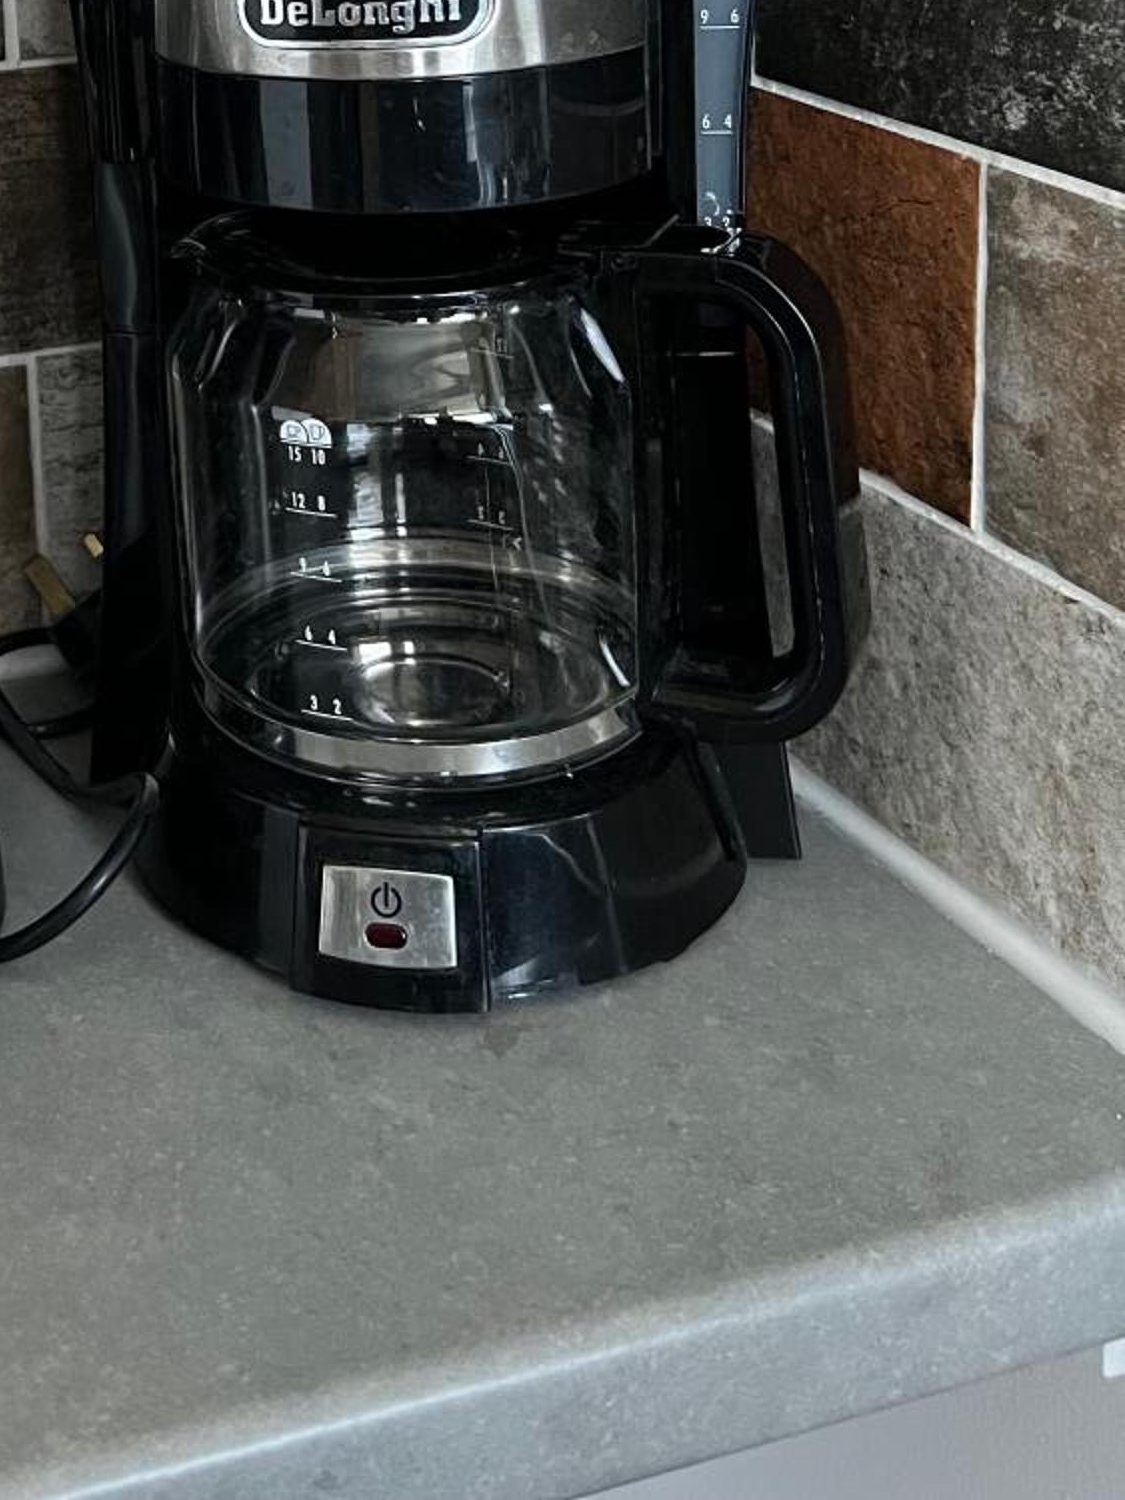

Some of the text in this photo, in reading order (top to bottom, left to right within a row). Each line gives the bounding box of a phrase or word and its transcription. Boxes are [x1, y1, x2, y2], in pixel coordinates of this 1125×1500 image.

[700, 8, 740, 24] 9 6
[701, 113, 732, 130] 6 4
[288, 445, 325, 466] 15 10
[291, 491, 326, 512] 12 8
[310, 694, 342, 715] 3 2
